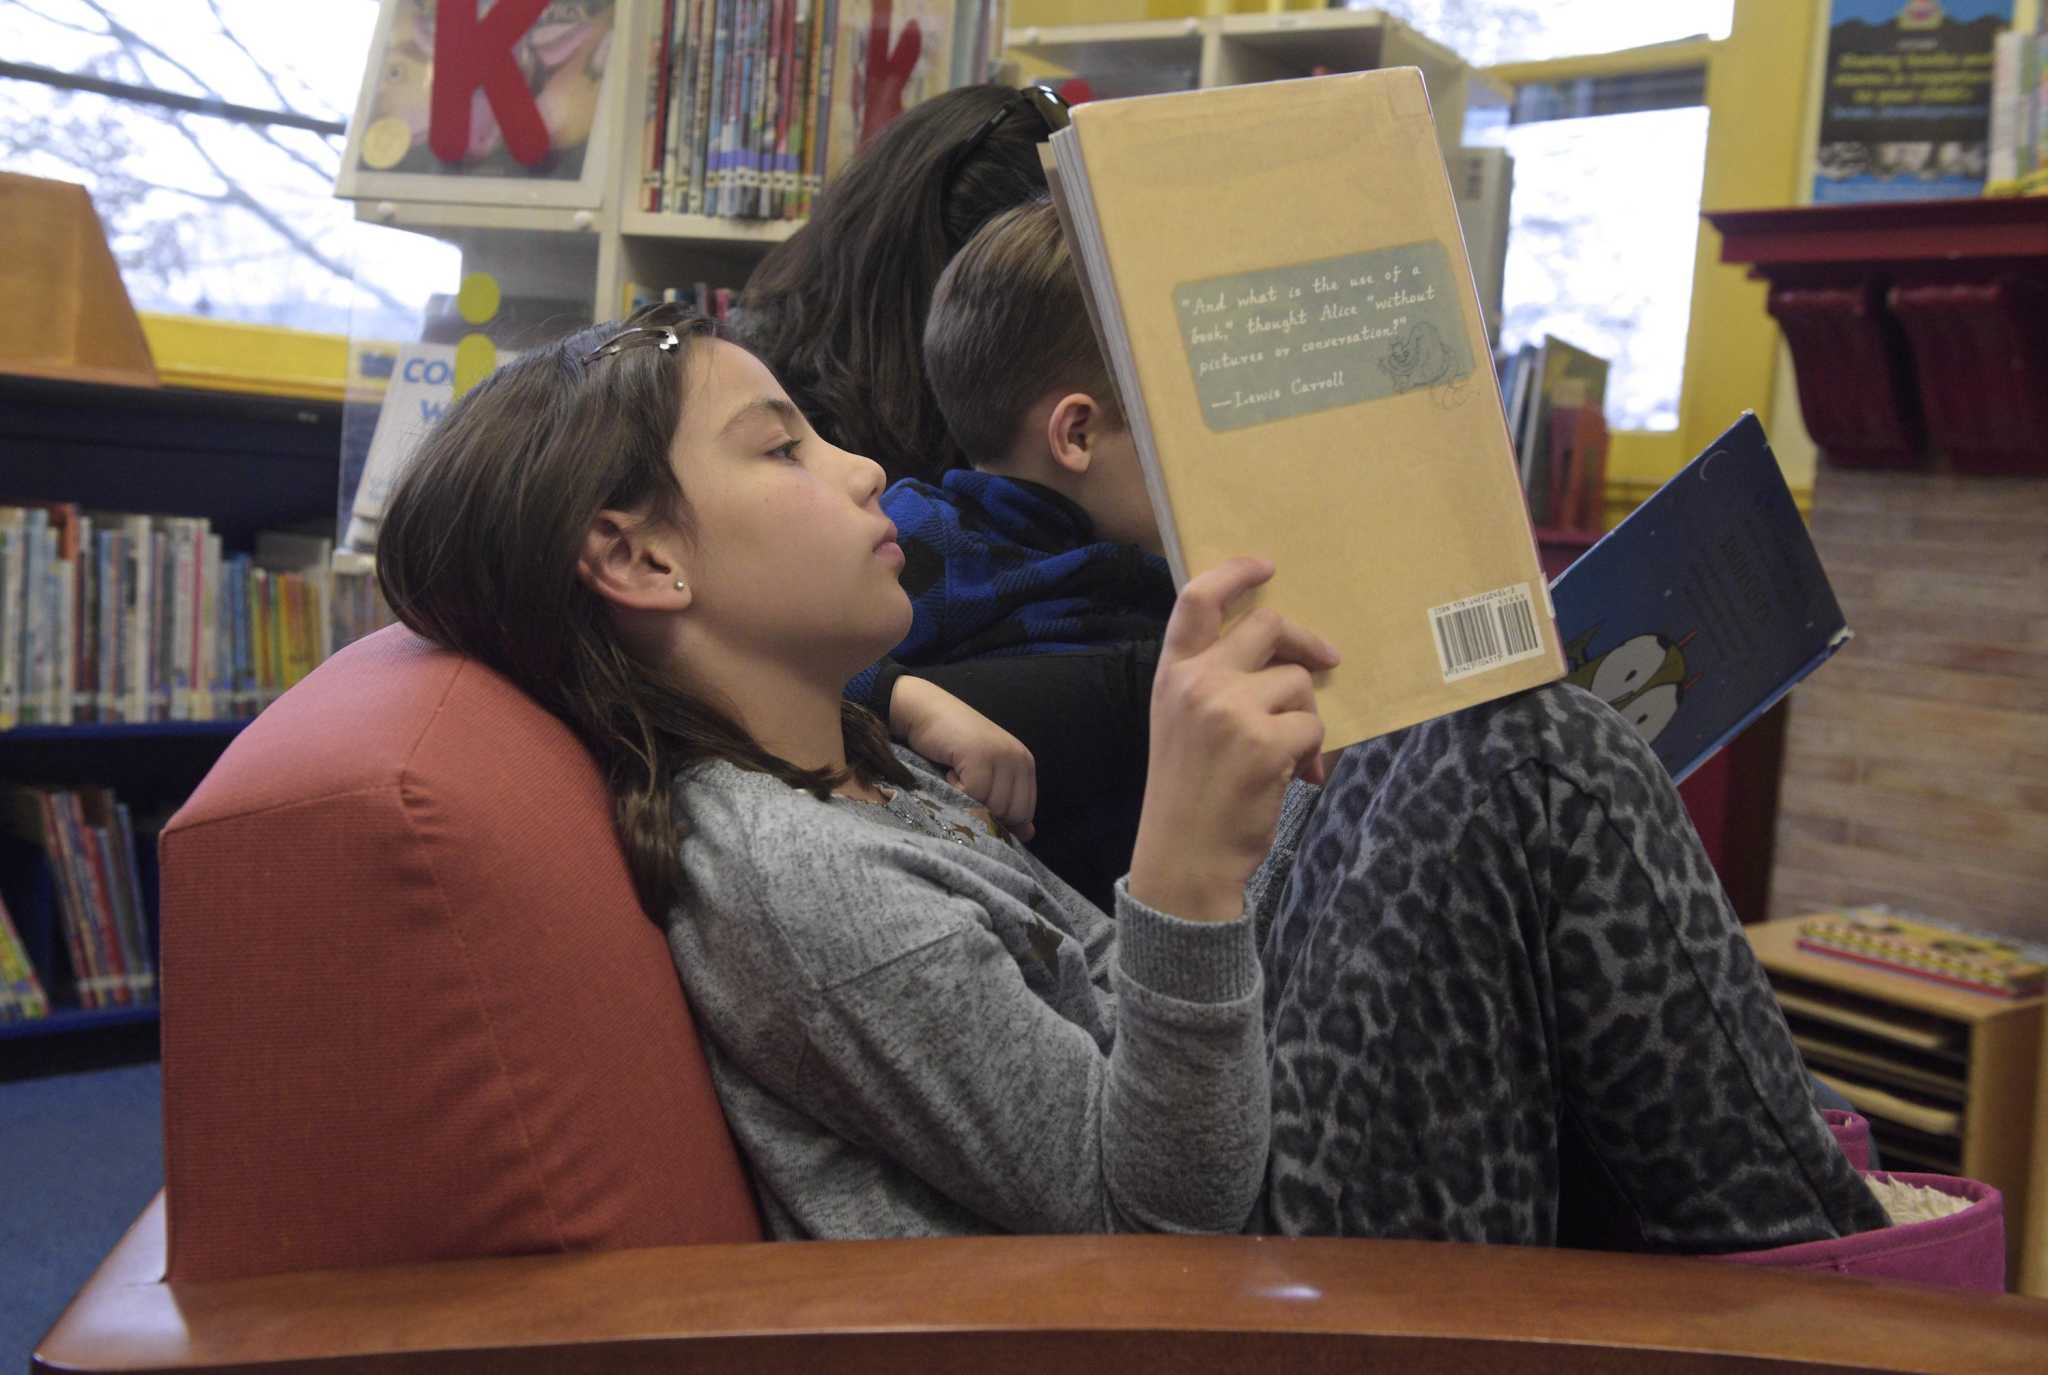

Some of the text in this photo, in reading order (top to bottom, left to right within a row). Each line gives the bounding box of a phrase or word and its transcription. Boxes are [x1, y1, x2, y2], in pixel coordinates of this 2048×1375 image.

[428, 0, 551, 167] K
[1237, 286, 1277, 308] what
[1289, 286, 1301, 299] is
[1312, 275, 1338, 294] the
[1350, 274, 1375, 287] use
[1384, 264, 1401, 283] of
[1411, 265, 1422, 276] a
[1247, 307, 1308, 335] thought
[1320, 303, 1359, 321] Alice
[1367, 284, 1436, 311] "without
[1199, 351, 1264, 376] pictures
[1274, 346, 1291, 358] or
[1290, 369, 1345, 395] Carroll
